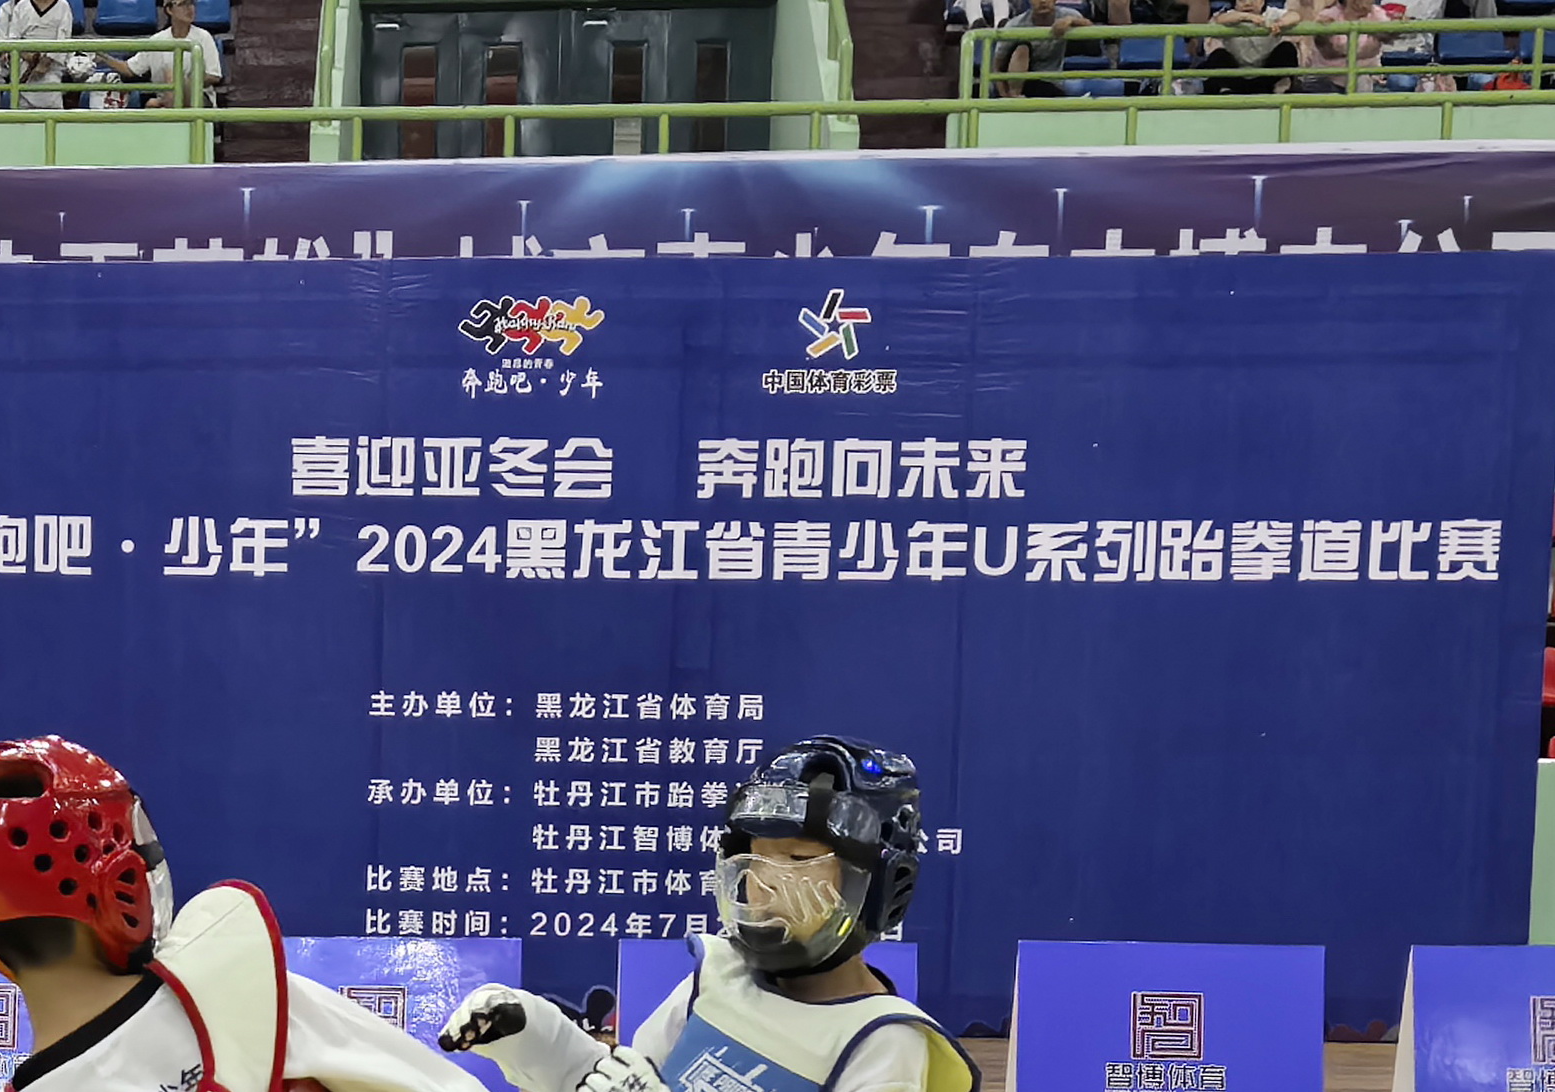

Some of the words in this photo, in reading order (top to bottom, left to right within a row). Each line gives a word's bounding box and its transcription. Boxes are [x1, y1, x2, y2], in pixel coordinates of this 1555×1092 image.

[762, 368, 898, 395] 中国体育彩票
[291, 436, 614, 499] 喜迎亚冬会
[696, 437, 1027, 499] 奔跑向未来
[534, 736, 763, 765] 黑龙江省教育厅
[1105, 1062, 1227, 1090] 智博体育
